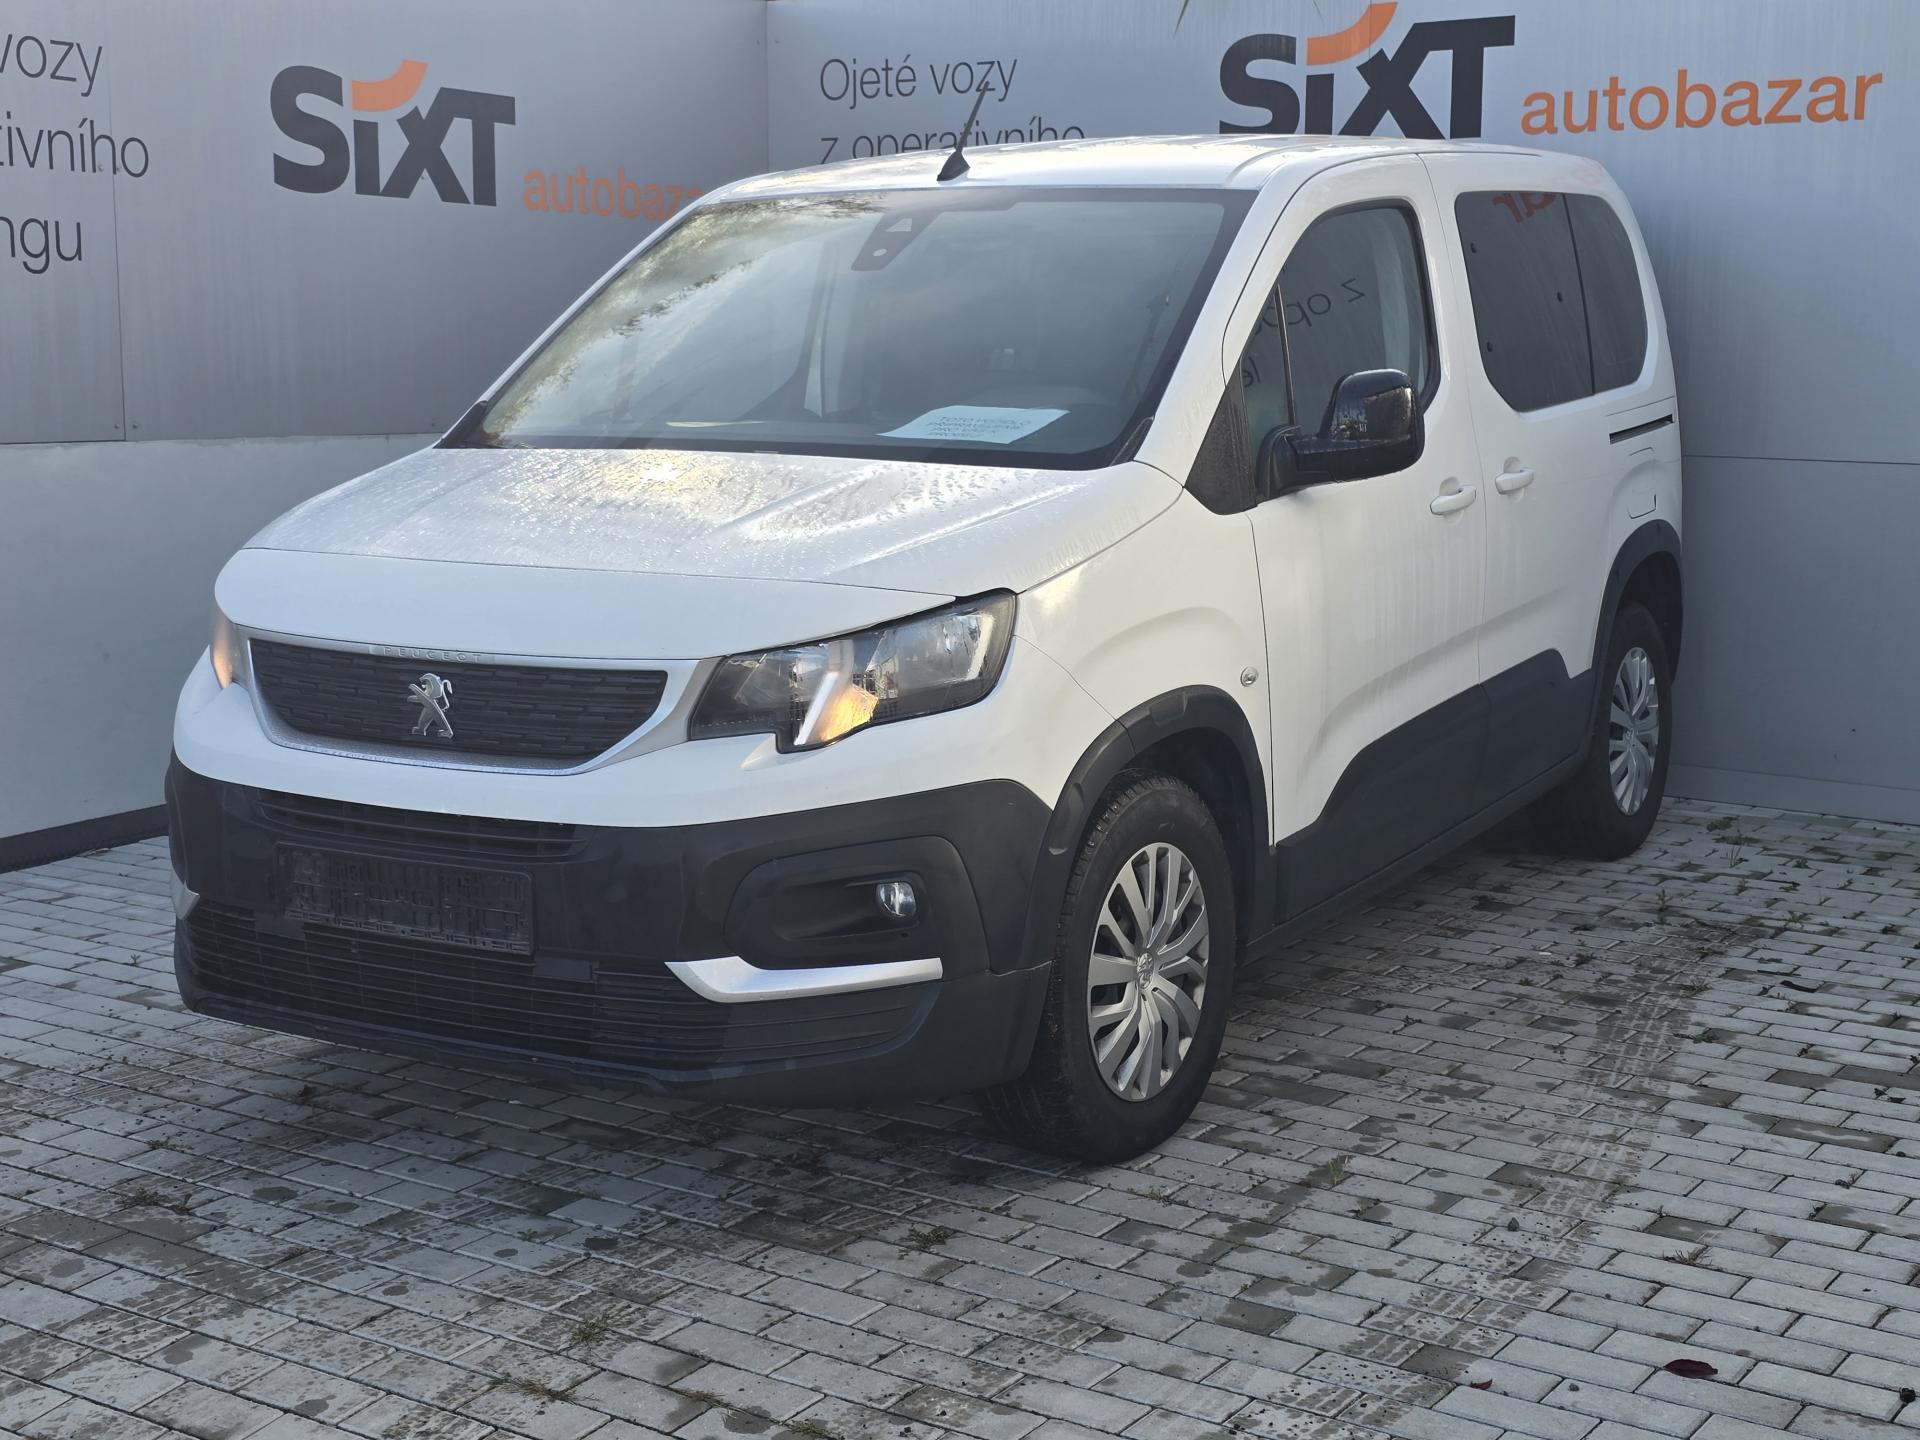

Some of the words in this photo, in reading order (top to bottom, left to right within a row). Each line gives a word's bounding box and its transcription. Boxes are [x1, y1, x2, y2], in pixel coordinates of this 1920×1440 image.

[820, 54, 917, 110] Ojeté
[929, 59, 1017, 102] vozy
[1520, 69, 1883, 135] autobazar
[0, 110, 149, 178] ivního
[820, 137, 839, 165] z
[523, 164, 705, 221] autobaz
